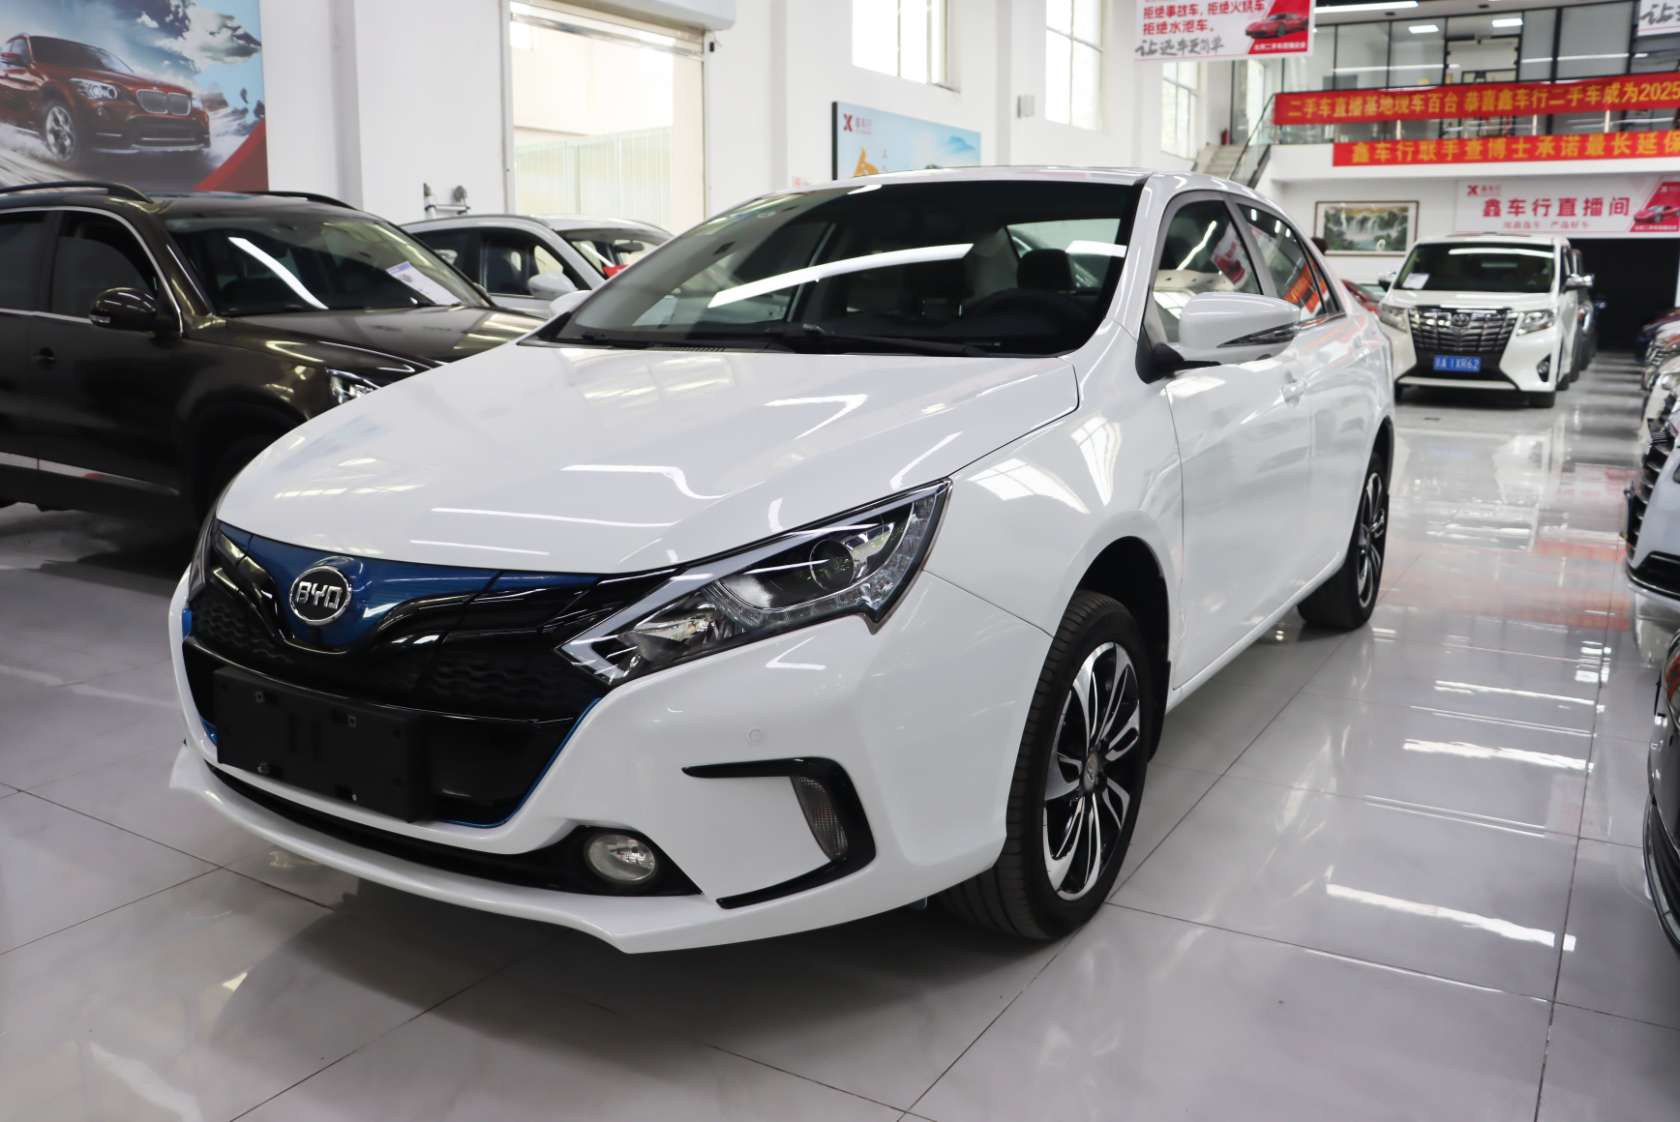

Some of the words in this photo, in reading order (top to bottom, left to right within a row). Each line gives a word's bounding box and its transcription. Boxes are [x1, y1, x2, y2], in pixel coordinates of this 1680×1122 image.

[1482, 196, 1631, 217] 鑫车行直播间
[296, 581, 342, 609] BYD
